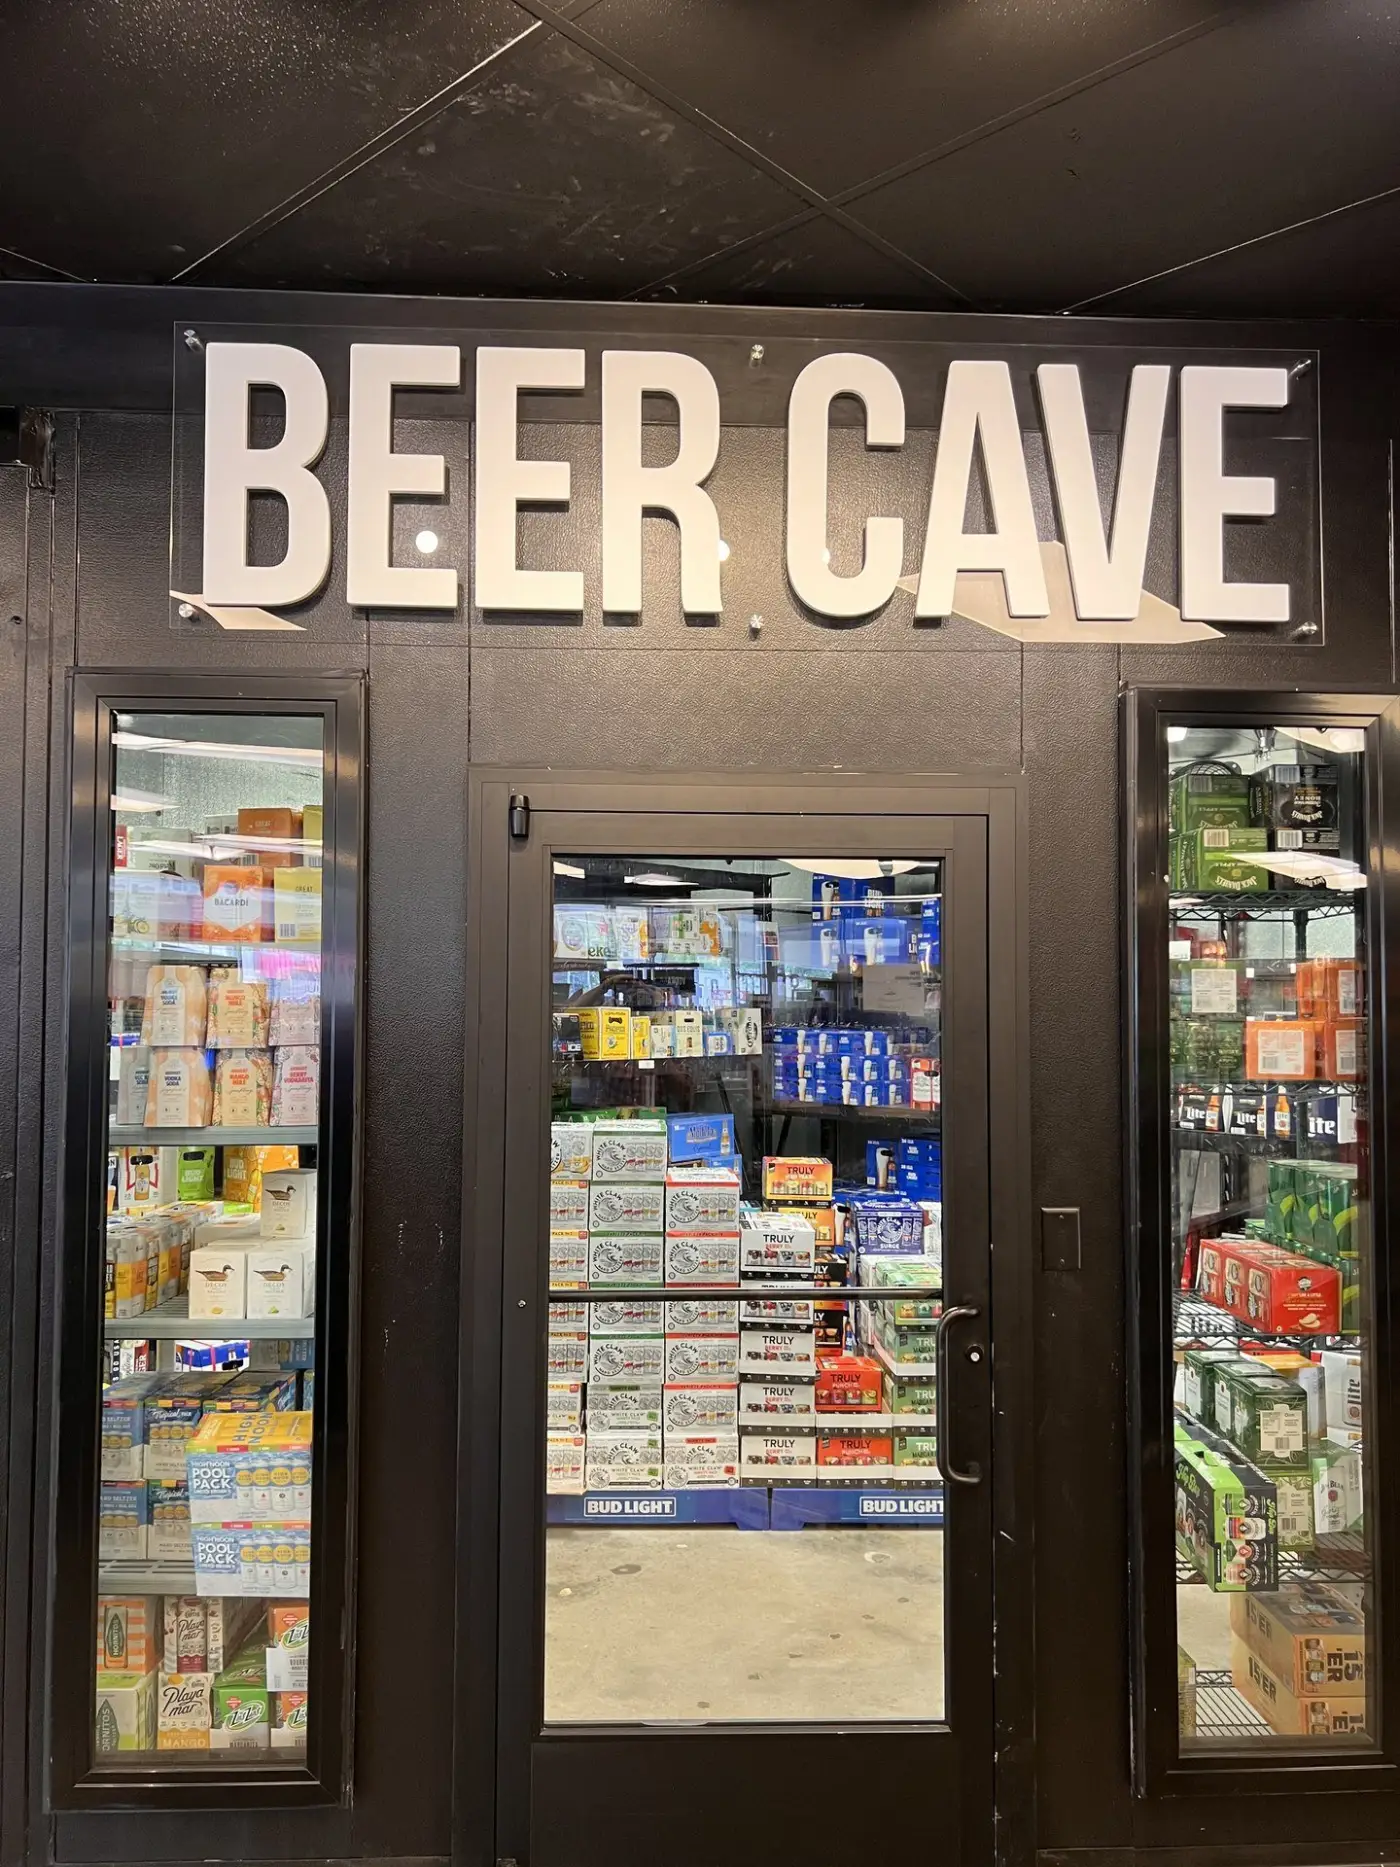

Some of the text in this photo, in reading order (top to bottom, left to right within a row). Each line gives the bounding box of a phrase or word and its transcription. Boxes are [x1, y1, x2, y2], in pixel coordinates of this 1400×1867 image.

[202, 341, 1291, 622] BEER CAVE
[1214, 875, 1257, 891] JACK DANIEL'S
[214, 898, 249, 907] BACARDI
[1184, 1106, 1206, 1120] Lite
[1237, 1111, 1257, 1126] Lite
[227, 1168, 247, 1181] LIGHT
[787, 1166, 815, 1175] TRULY
[763, 1234, 795, 1244] TRULY
[762, 1335, 795, 1345] TRULY
[831, 1374, 861, 1383] TRULY
[763, 1387, 795, 1396] TRULY
[915, 1389, 936, 1399] TRU
[248, 1412, 274, 1444] NOON
[763, 1438, 796, 1448] TRULY
[840, 1440, 872, 1449] TRULY
[915, 1442, 937, 1451] TRU
[192, 1467, 230, 1478] POOL
[193, 1478, 232, 1489] PACK
[587, 1501, 672, 1514] BUD LIGHT
[863, 1500, 897, 1513] BUD
[198, 1542, 235, 1554] POOL
[199, 1553, 236, 1565] PACK
[178, 1619, 205, 1638] Playa
[181, 1631, 203, 1642] mar
[1343, 1650, 1364, 1681] 15
[163, 1687, 204, 1714] Playa
[168, 1703, 203, 1717] mar
[162, 1738, 206, 1748] MANGO
